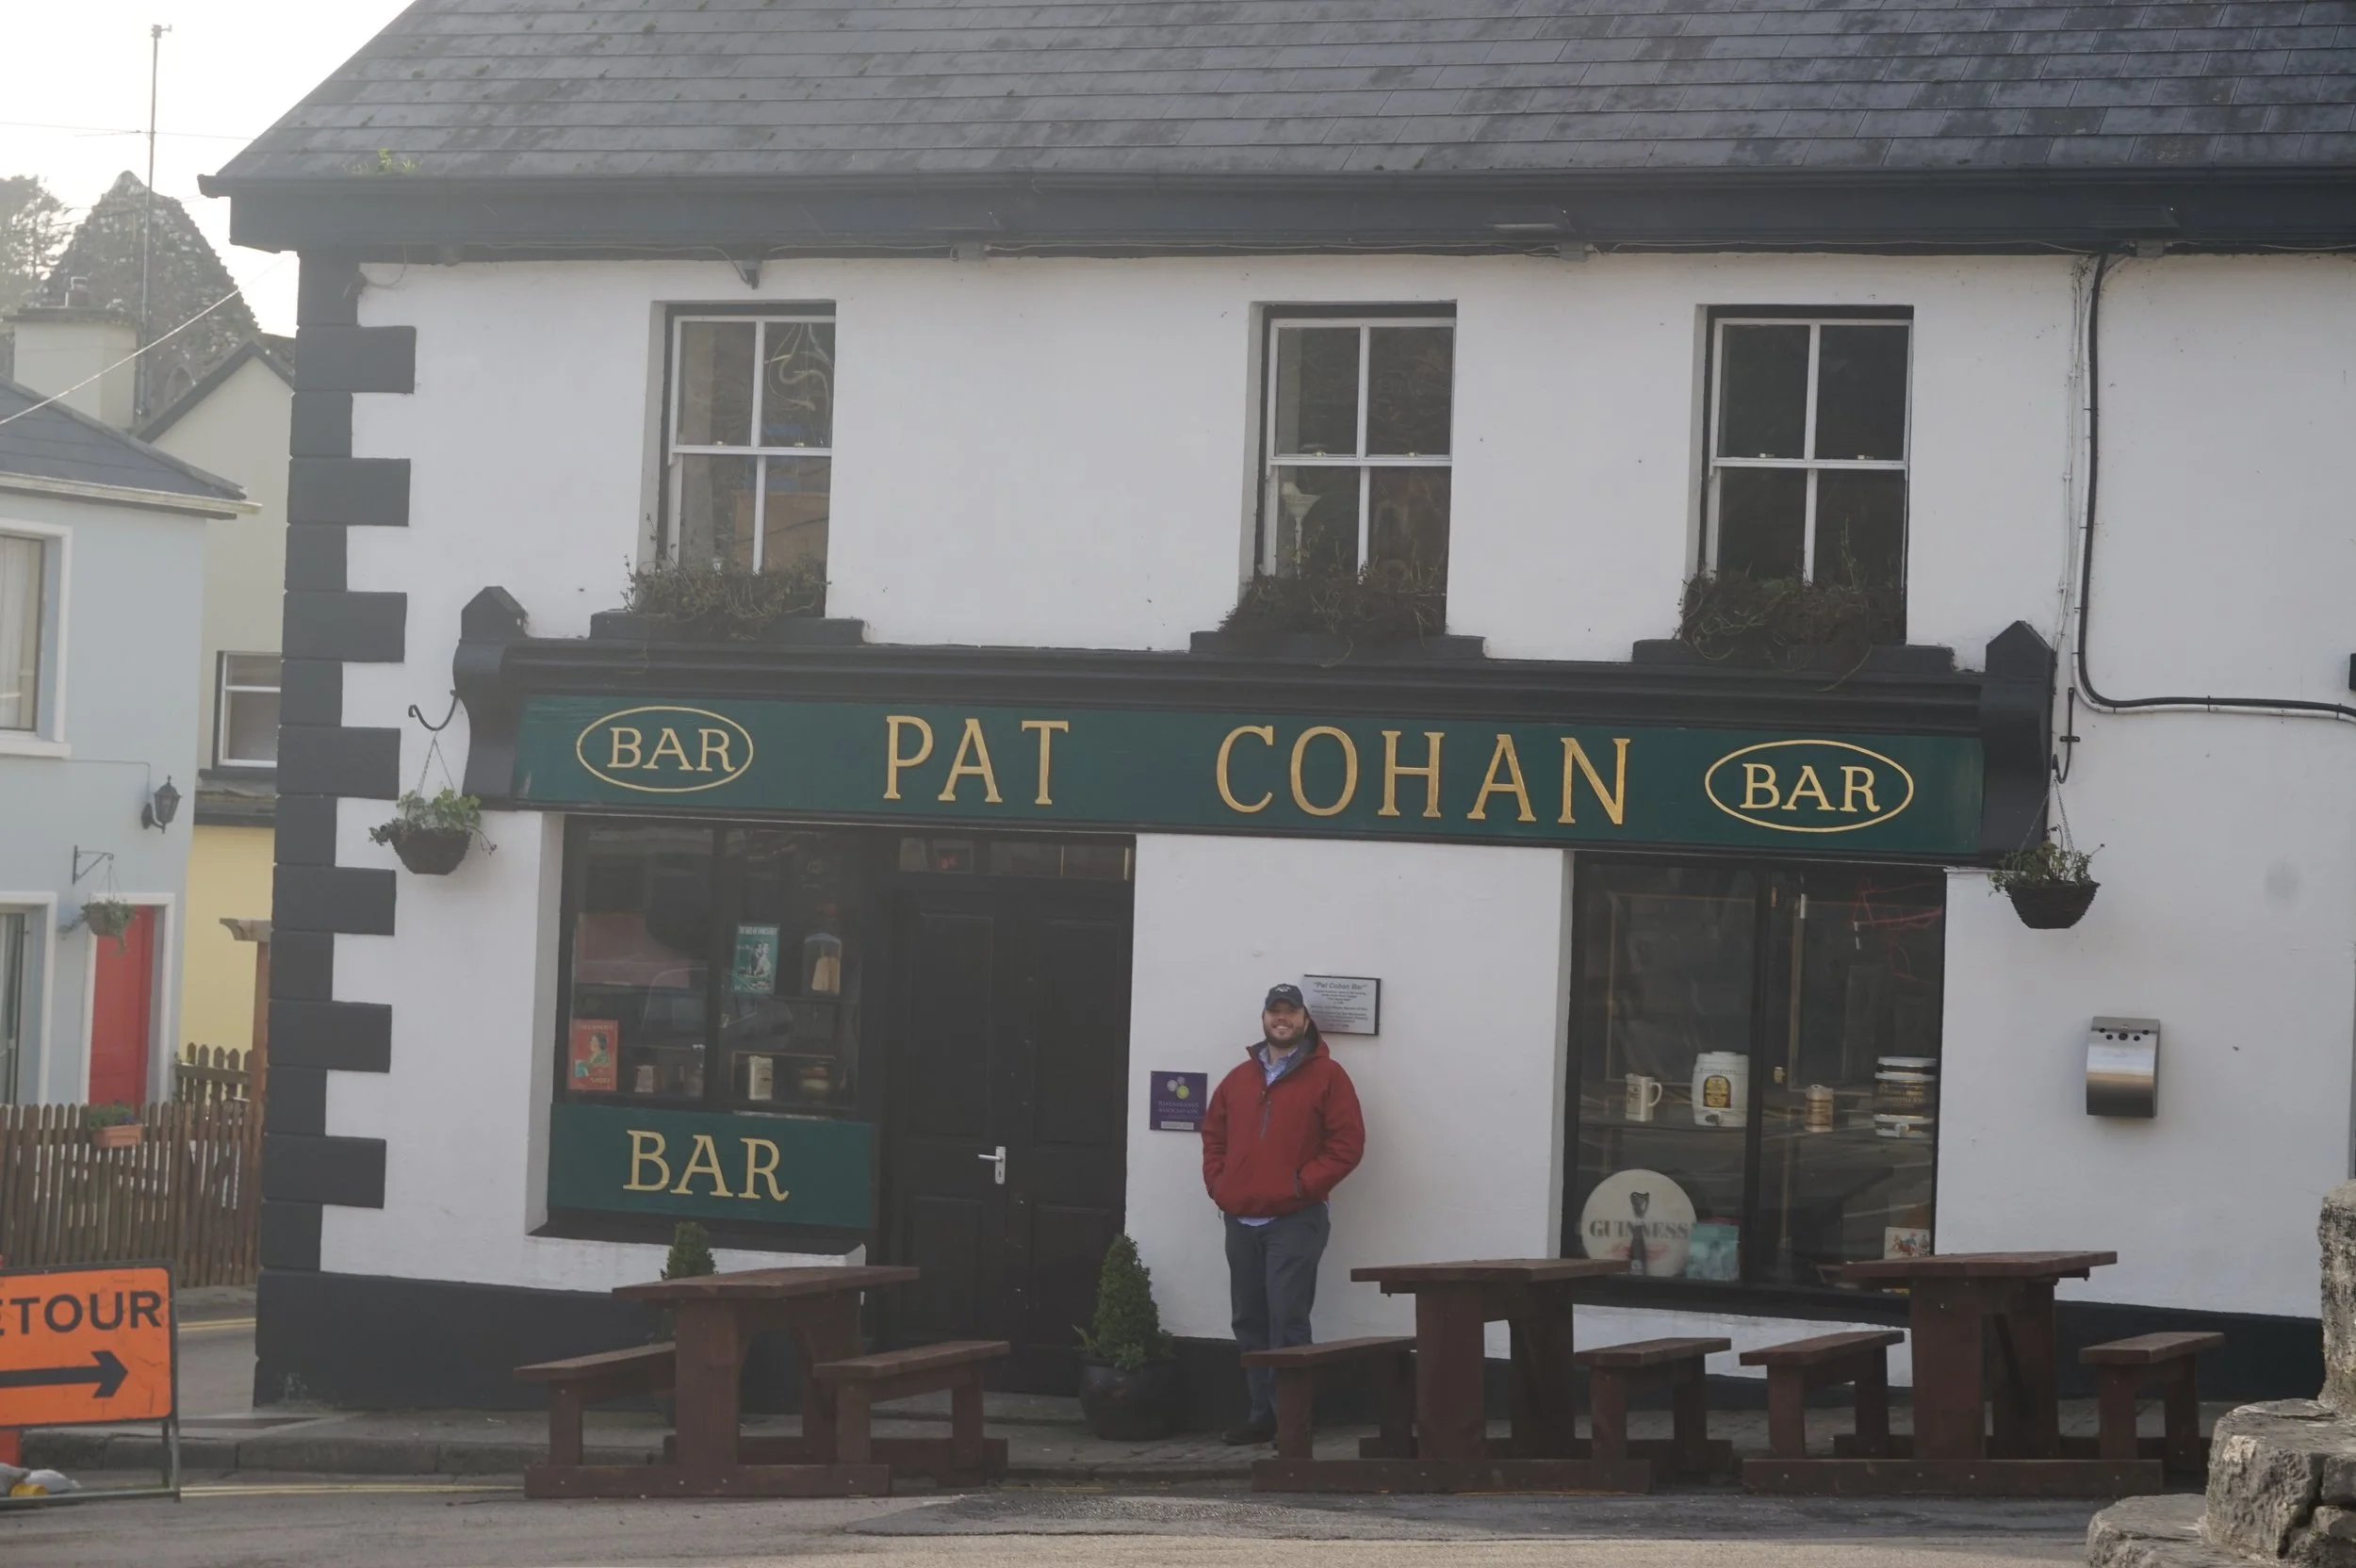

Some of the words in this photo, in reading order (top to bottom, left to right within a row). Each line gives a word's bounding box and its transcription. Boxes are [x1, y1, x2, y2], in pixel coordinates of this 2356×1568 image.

[607, 727, 736, 772] BAR
[883, 715, 1070, 806] PAT
[1216, 725, 1632, 826] COHAN
[1740, 762, 1881, 813] BAR
[623, 1130, 790, 1201] BAR
[0, 1290, 162, 1336] TOUR
